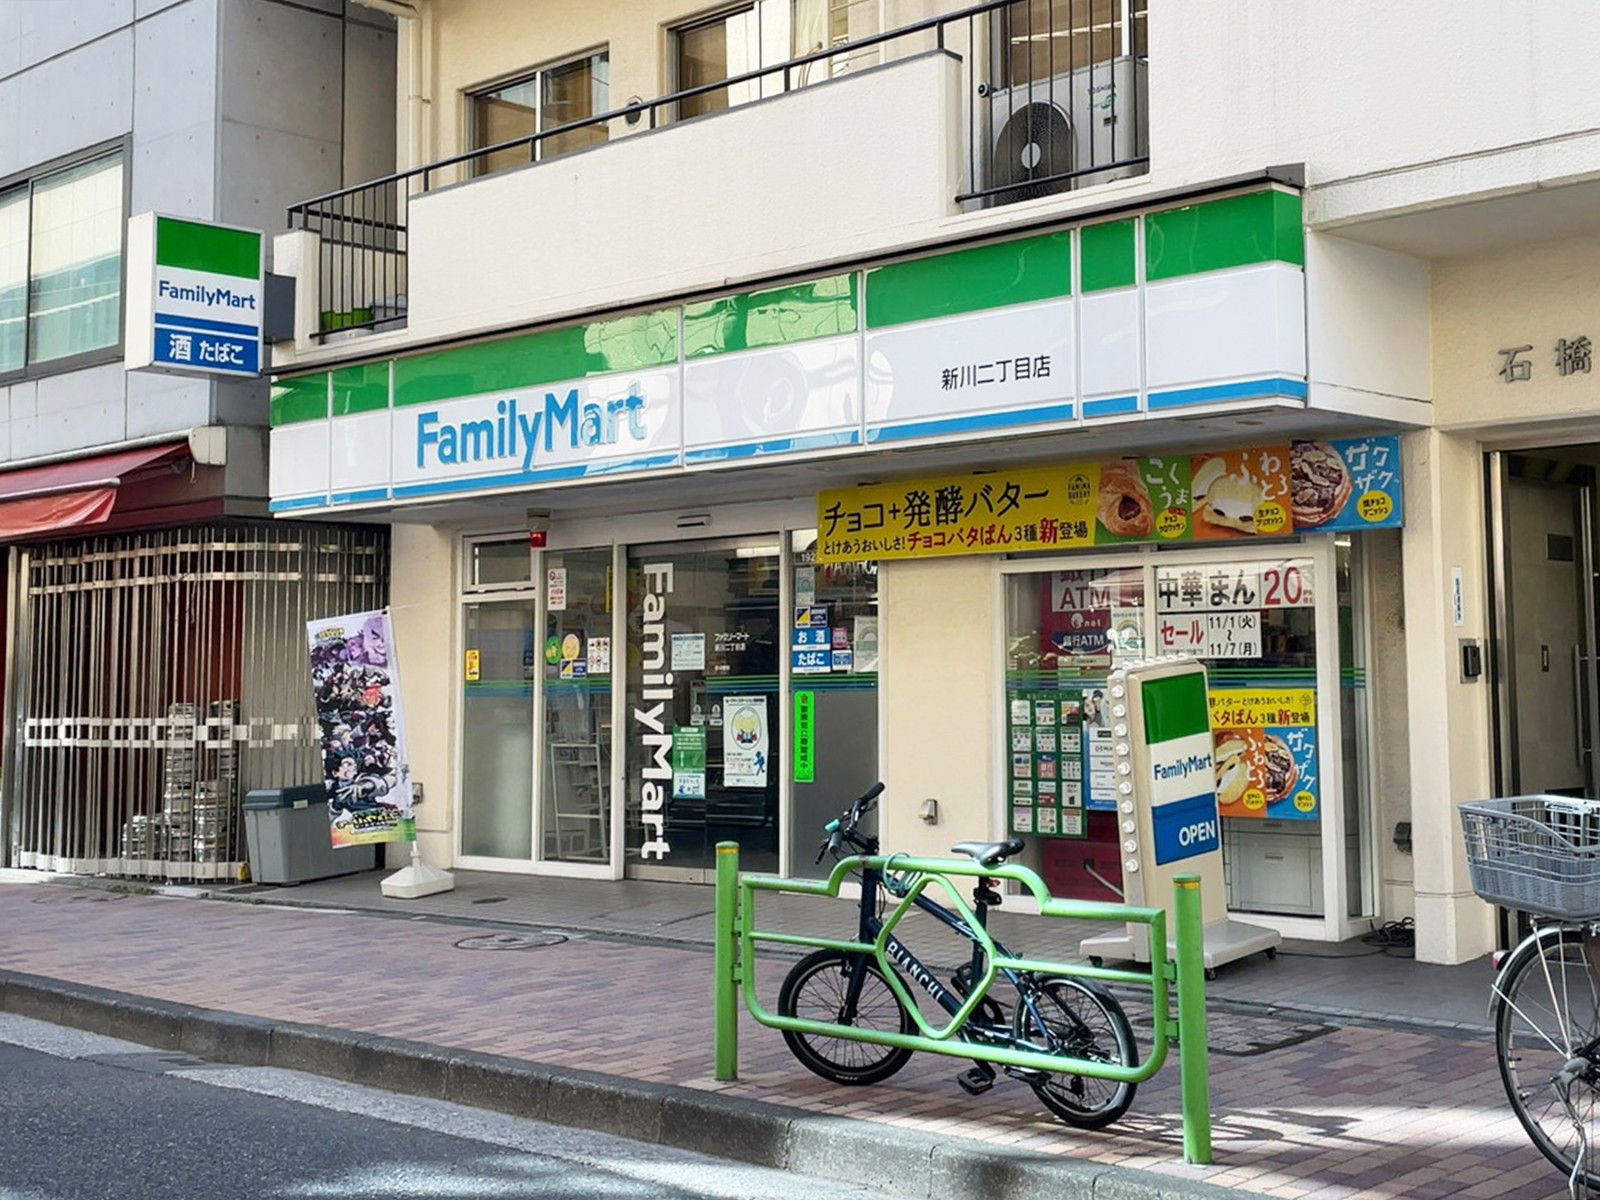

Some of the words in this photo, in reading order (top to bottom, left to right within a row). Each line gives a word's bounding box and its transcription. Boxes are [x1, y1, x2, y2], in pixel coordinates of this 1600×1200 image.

[159, 280, 256, 310] FamilyMart
[169, 333, 192, 361] 酒
[199, 340, 244, 365] たばこ
[1497, 336, 1592, 383] 石橋
[941, 354, 1051, 391] 新川二丁目店
[417, 380, 647, 473] FamilyMart
[824, 481, 1050, 537] チョコ+発酵バター
[1060, 586, 1111, 610] ATM
[1158, 568, 1255, 608] 中華まん
[1263, 565, 1303, 605] 20
[1160, 619, 1204, 646] セール
[797, 652, 825, 666] たばこ
[634, 562, 674, 860] FamilyMart
[1153, 751, 1213, 781] FamilyMart
[1178, 820, 1216, 847] OPEN
